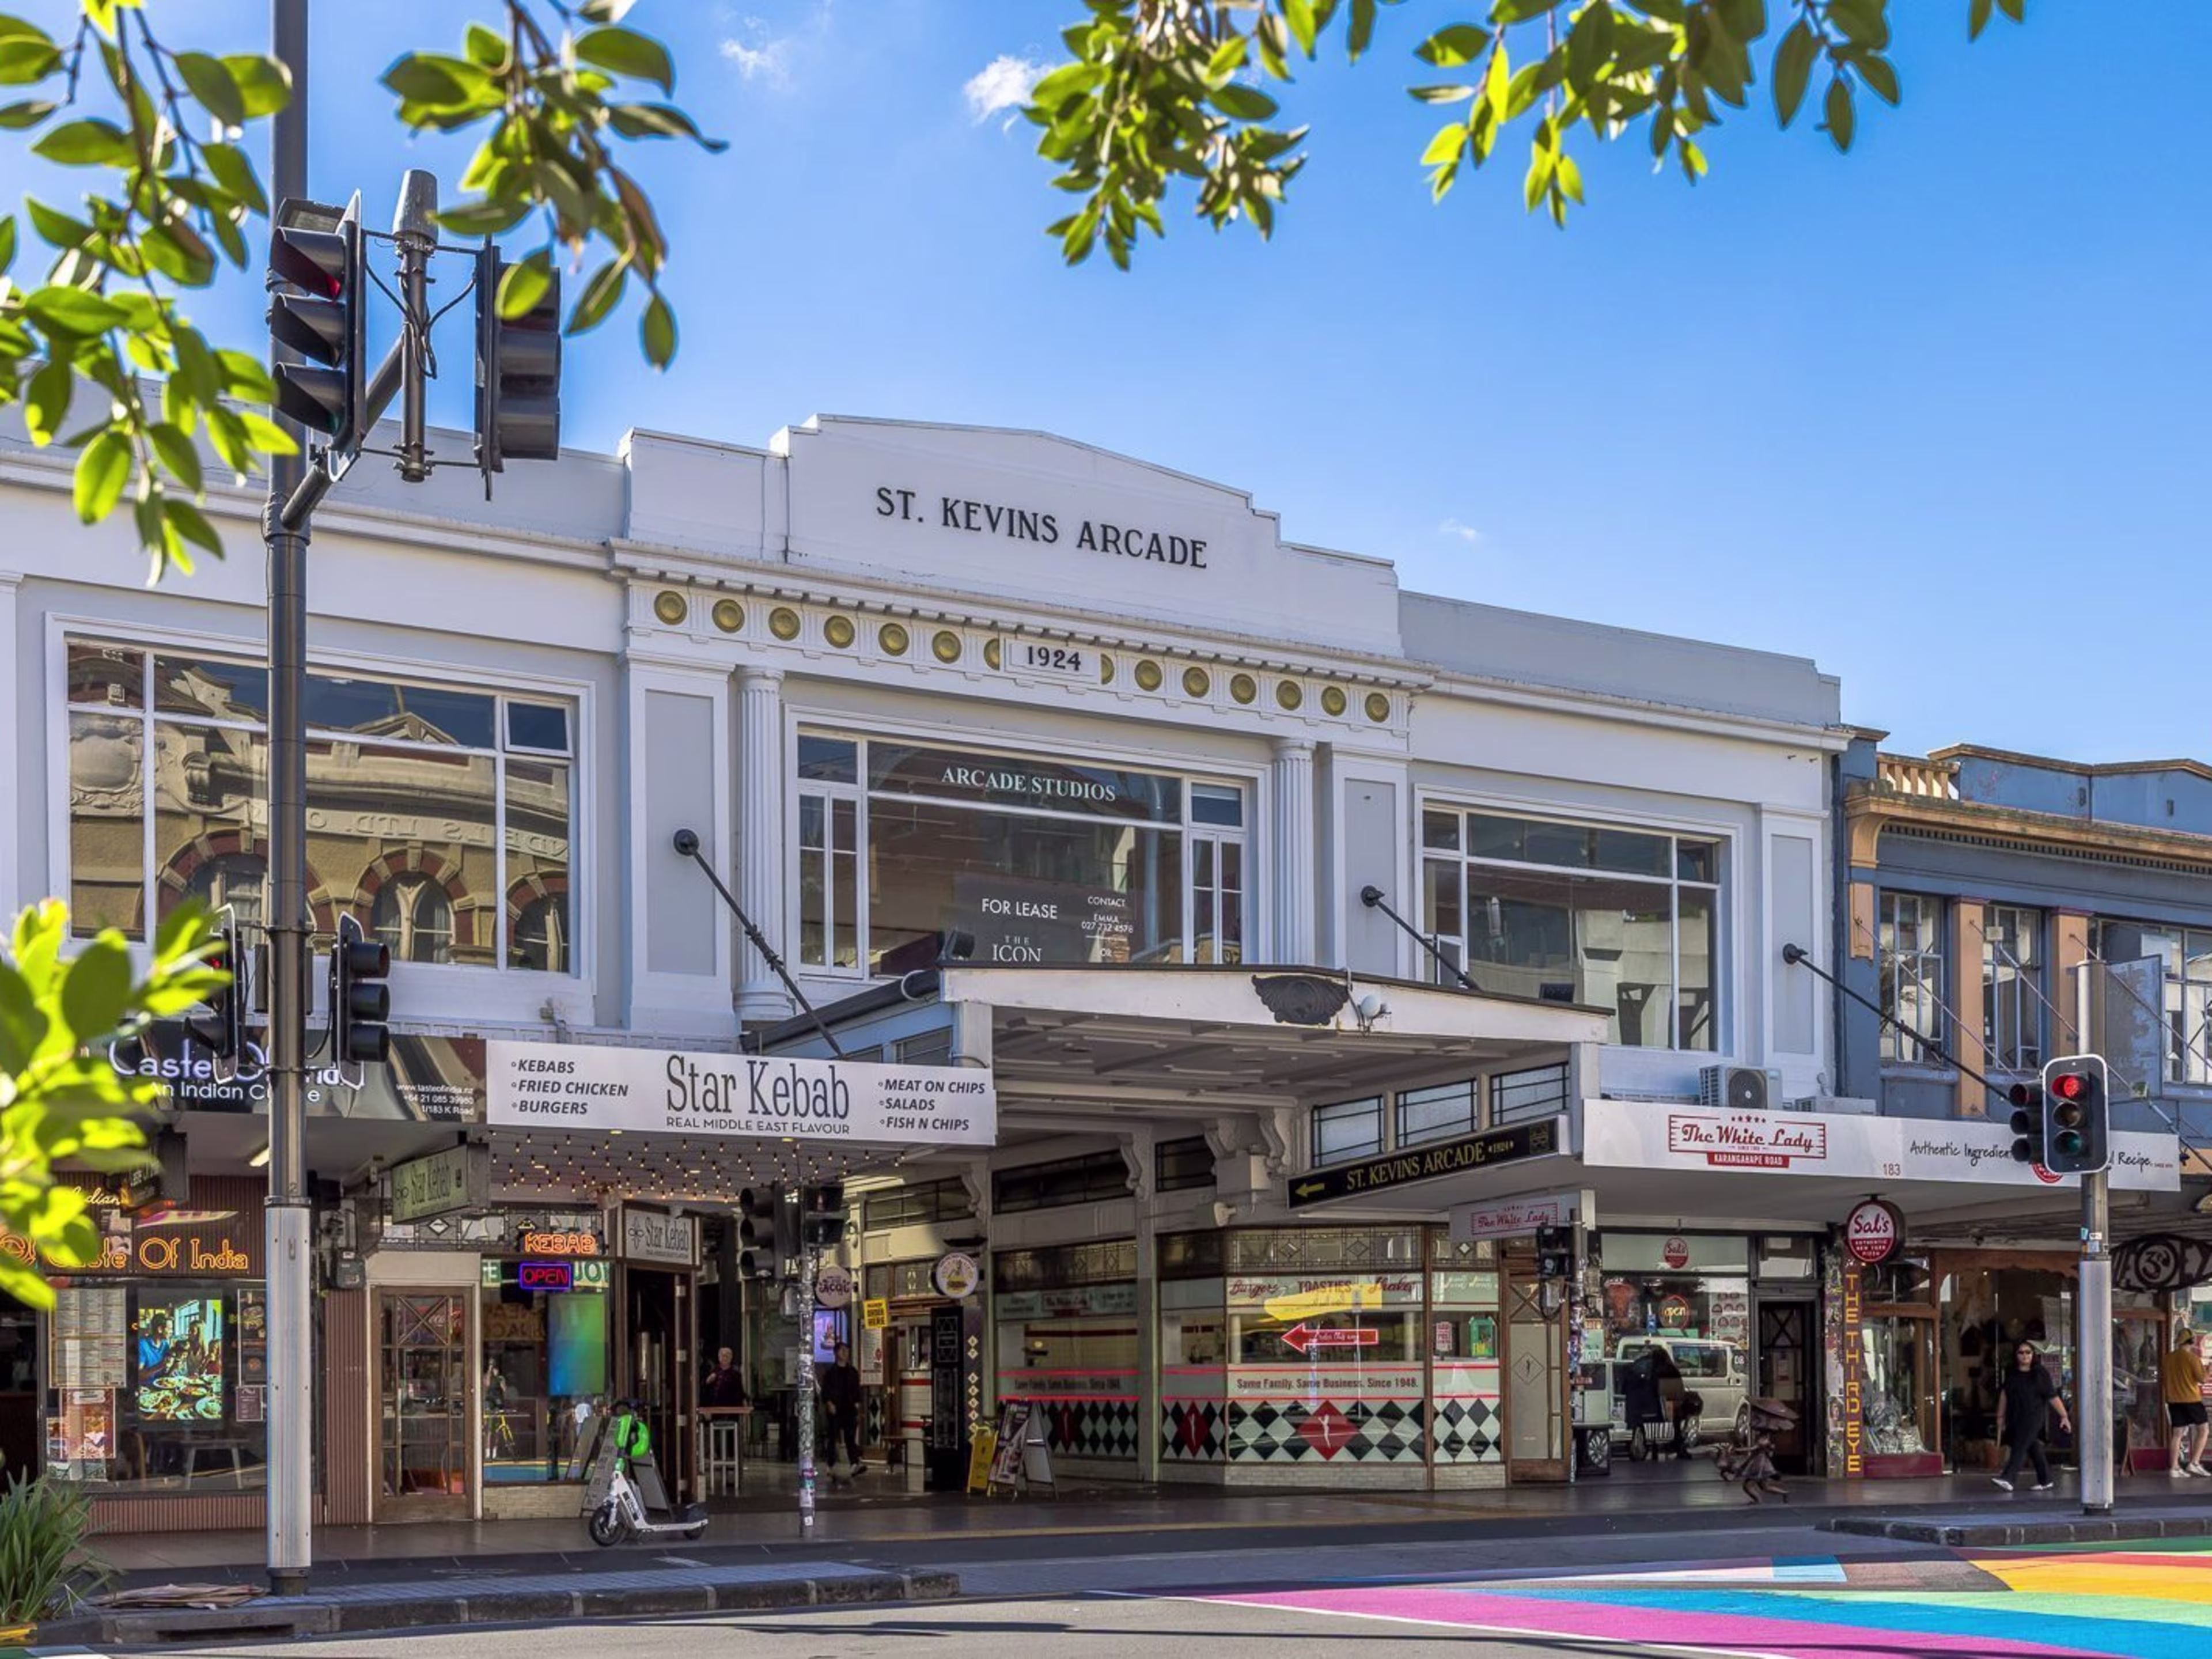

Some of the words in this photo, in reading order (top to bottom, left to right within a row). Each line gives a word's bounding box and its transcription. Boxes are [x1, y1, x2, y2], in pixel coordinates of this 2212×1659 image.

[876, 487, 925, 523] ST.
[942, 497, 1059, 544] KEVINS
[1077, 521, 1208, 569] ARCADE
[1027, 645, 1081, 672] 1924
[941, 767, 1026, 792] ARCADE
[1031, 777, 1116, 802] STUDIOS
[982, 898, 1011, 915] FOR
[1016, 901, 1058, 919] LEASE
[1088, 896, 1126, 907] CONTACT
[1005, 935, 1030, 945] THE
[993, 944, 1042, 963] ICON
[518, 1059, 575, 1074] KEBABS
[181, 1082, 244, 1101] Indian
[518, 1080, 562, 1093] FRIED
[565, 1082, 629, 1097] CHICKEN
[666, 1055, 737, 1113] Star
[747, 1060, 850, 1119] Kebab
[884, 1079, 922, 1092] MEAT
[925, 1080, 945, 1092] ON
[948, 1081, 986, 1094] CHIPS
[518, 1100, 588, 1115] BURGERS
[885, 1097, 935, 1111] SALADS
[666, 1116, 700, 1128] REAL
[703, 1118, 752, 1131] MIDDLE
[757, 1121, 788, 1132] EAST
[792, 1122, 850, 1134] FLAVOUR
[887, 1116, 915, 1129] FISH
[918, 1118, 929, 1130] N
[932, 1118, 969, 1131] CHIPS
[1682, 1124, 1714, 1143] The
[1716, 1125, 1765, 1145] White
[1768, 1128, 1814, 1153] Lady
[1910, 1139, 1960, 1156] Authentic
[1964, 1143, 2012, 1166] Ingredien
[1347, 1171, 1366, 1190] ST.
[1369, 1156, 1420, 1185] KEVINS
[1423, 1141, 1485, 1173] ARCADE
[1882, 1163, 1901, 1176] 183
[1854, 1214, 1889, 1234] Sal's
[139, 1237, 181, 1268] Of
[190, 1238, 248, 1269] India
[524, 1232, 597, 1256] KEBAB
[522, 1268, 569, 1284] OPEN
[1298, 1280, 1353, 1294] TOASTIES
[1846, 1274, 1859, 1323] THE
[1846, 1331, 1861, 1412] THIRD
[1237, 1378, 1261, 1389] Same
[1297, 1378, 1320, 1389] Same
[1368, 1377, 1391, 1388] Since
[1846, 1421, 1861, 1472] EYE
